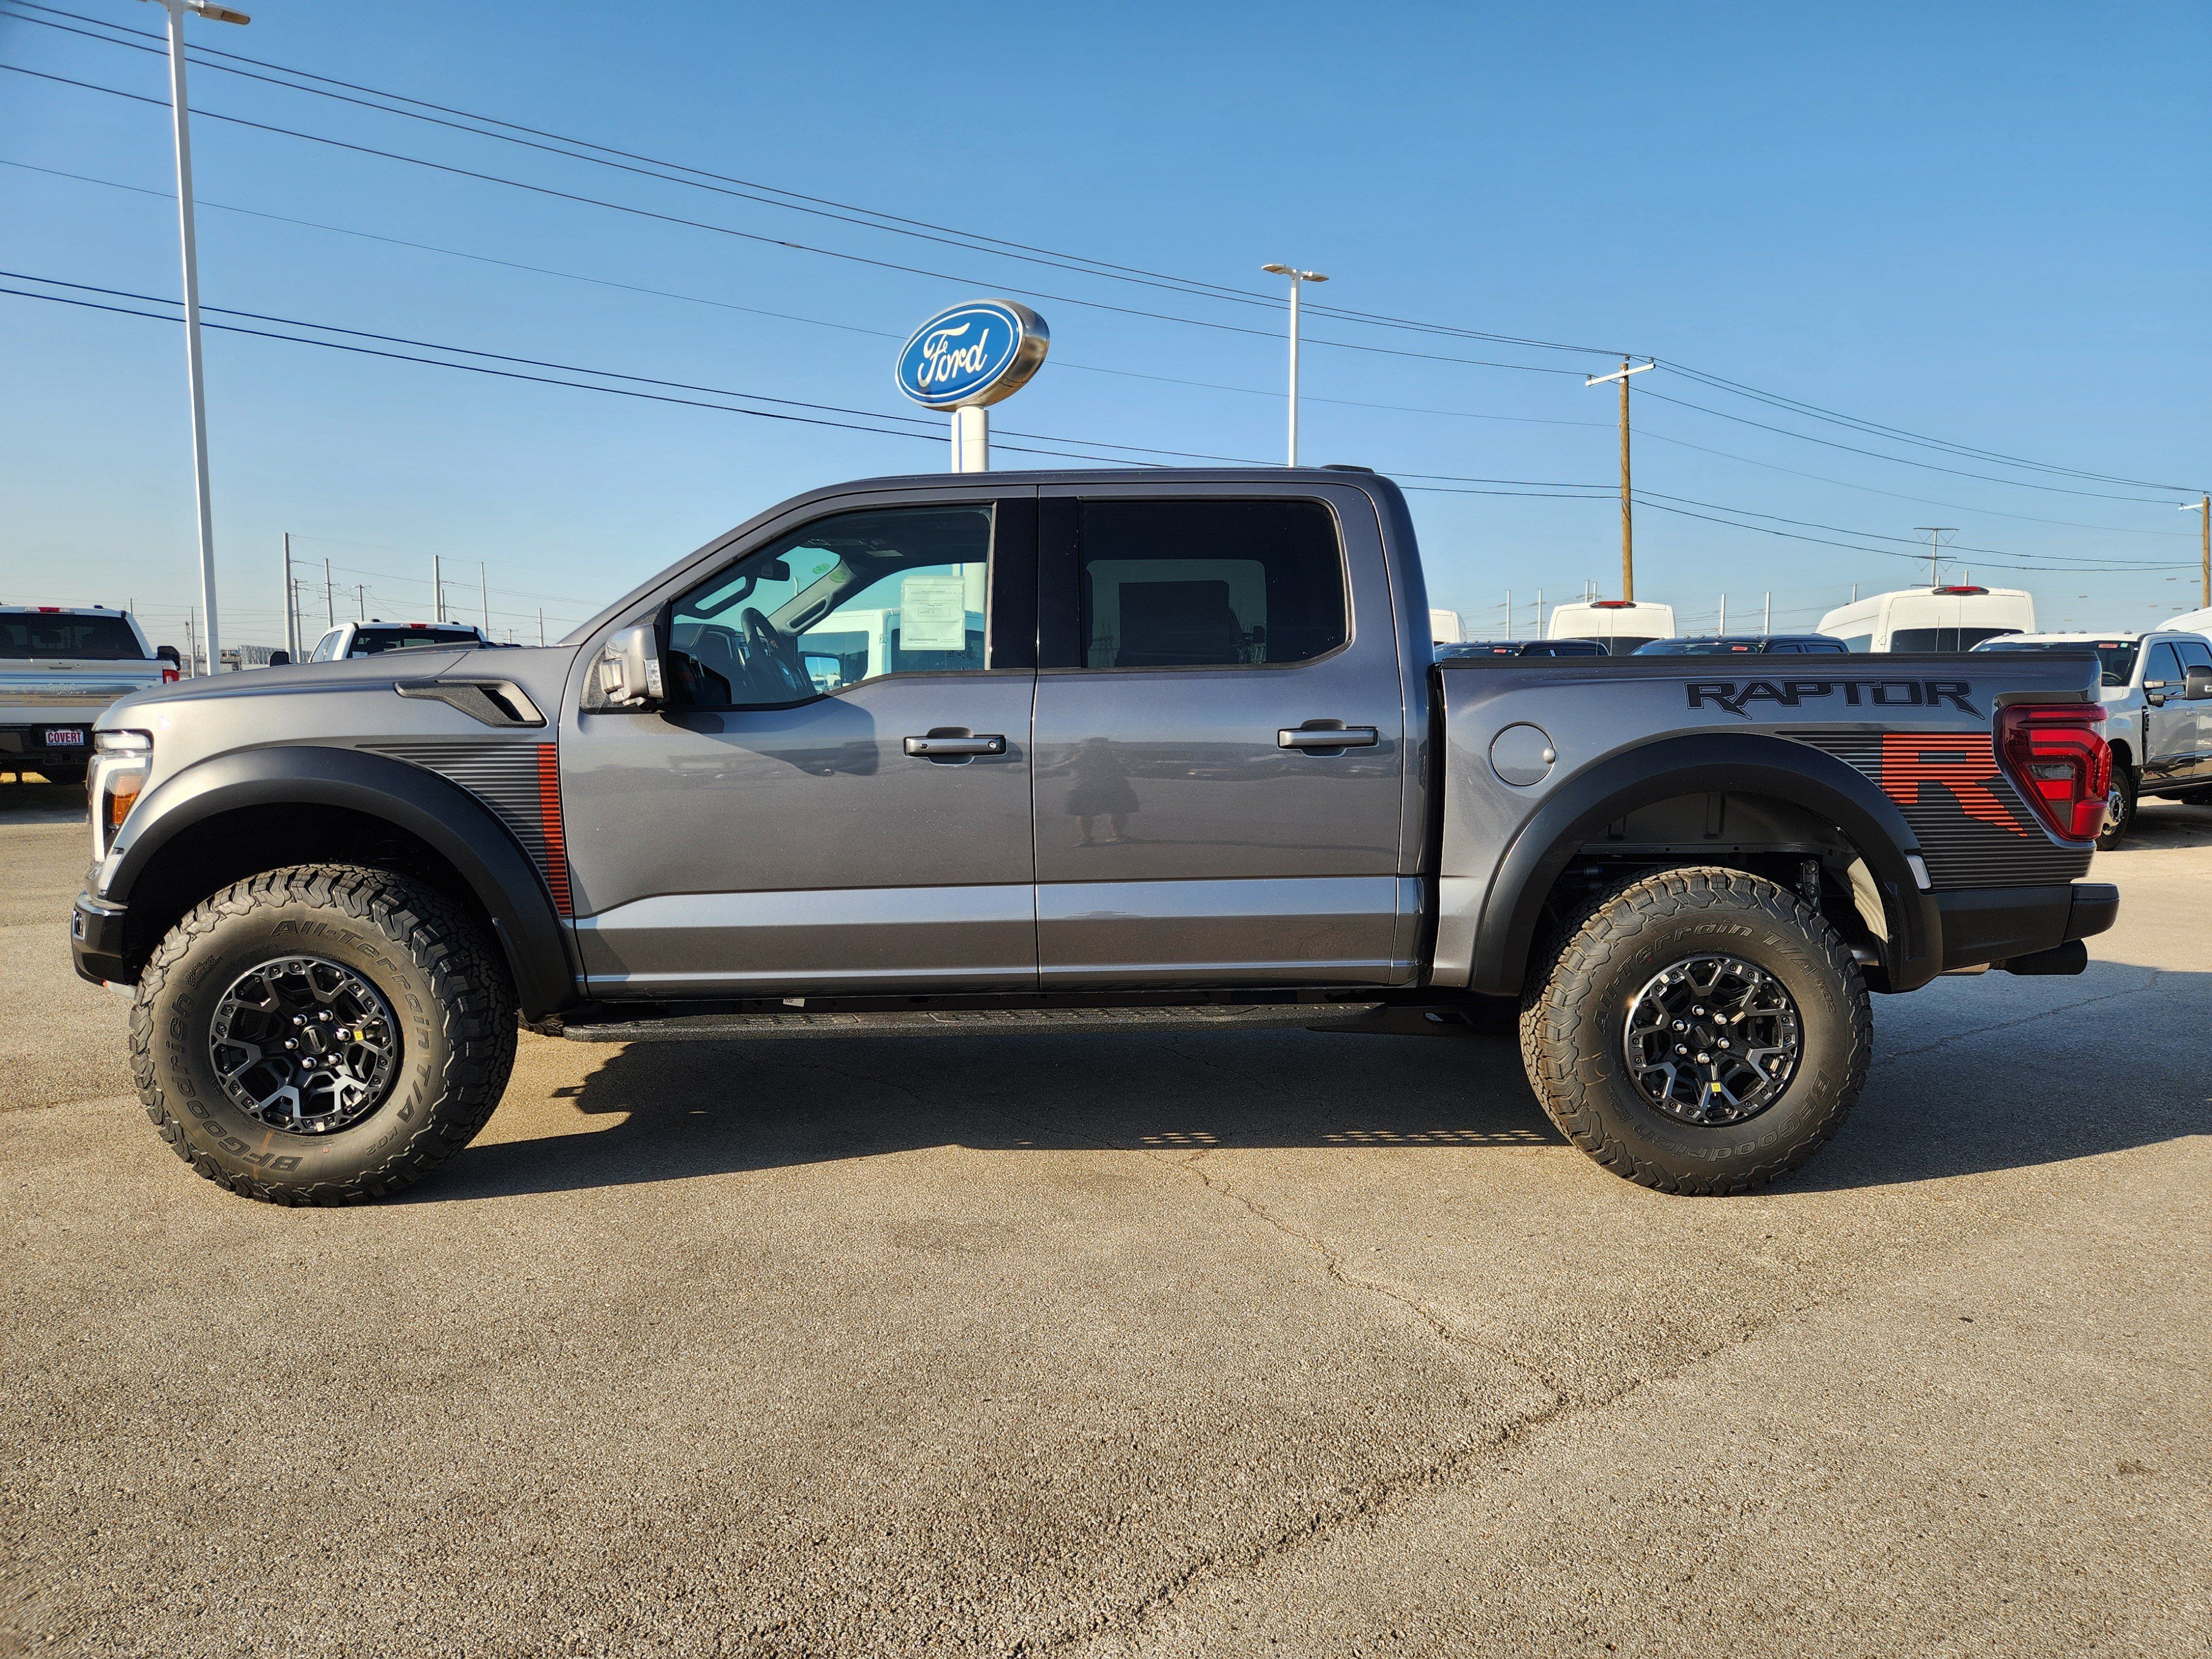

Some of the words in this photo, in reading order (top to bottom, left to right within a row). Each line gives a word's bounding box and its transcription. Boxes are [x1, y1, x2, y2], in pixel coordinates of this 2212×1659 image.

[917, 322, 989, 388] Ford
[1684, 679, 1985, 721] RAPTOR
[48, 732, 81, 743] COVERT
[1816, 978, 1837, 1015] KO2
[170, 993, 304, 1172] BFGoodrich
[1632, 1070, 1832, 1162] BFGoodrich
[366, 1127, 399, 1157] KO2
